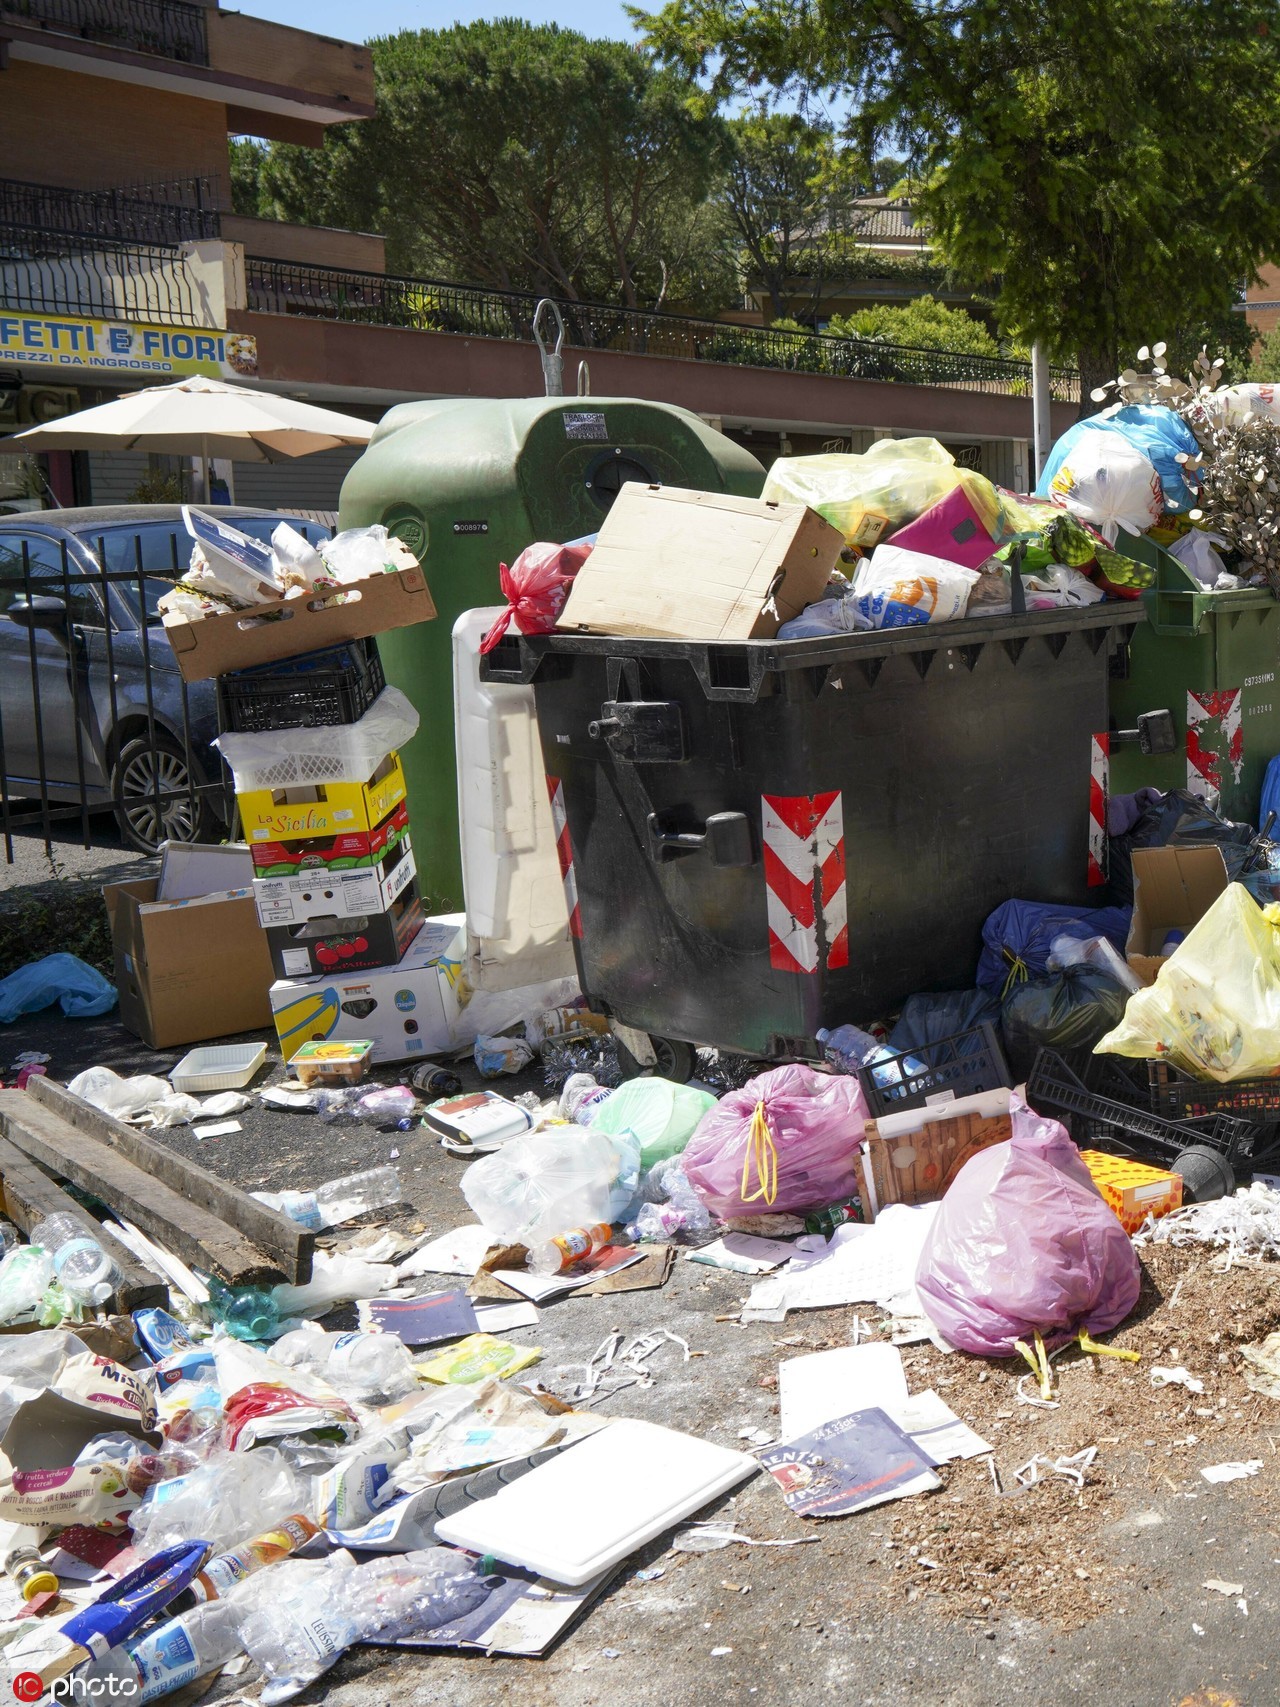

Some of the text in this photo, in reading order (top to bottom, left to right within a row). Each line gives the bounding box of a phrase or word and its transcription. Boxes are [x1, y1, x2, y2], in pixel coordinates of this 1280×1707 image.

[109, 327, 131, 354] E
[143, 330, 225, 363] FIORI
[59, 355, 83, 365] DA
[90, 357, 172, 371] INGROSSO
[257, 814, 273, 824] La
[272, 808, 327, 833] Sicilia
[812, 1432, 825, 1441] 24
